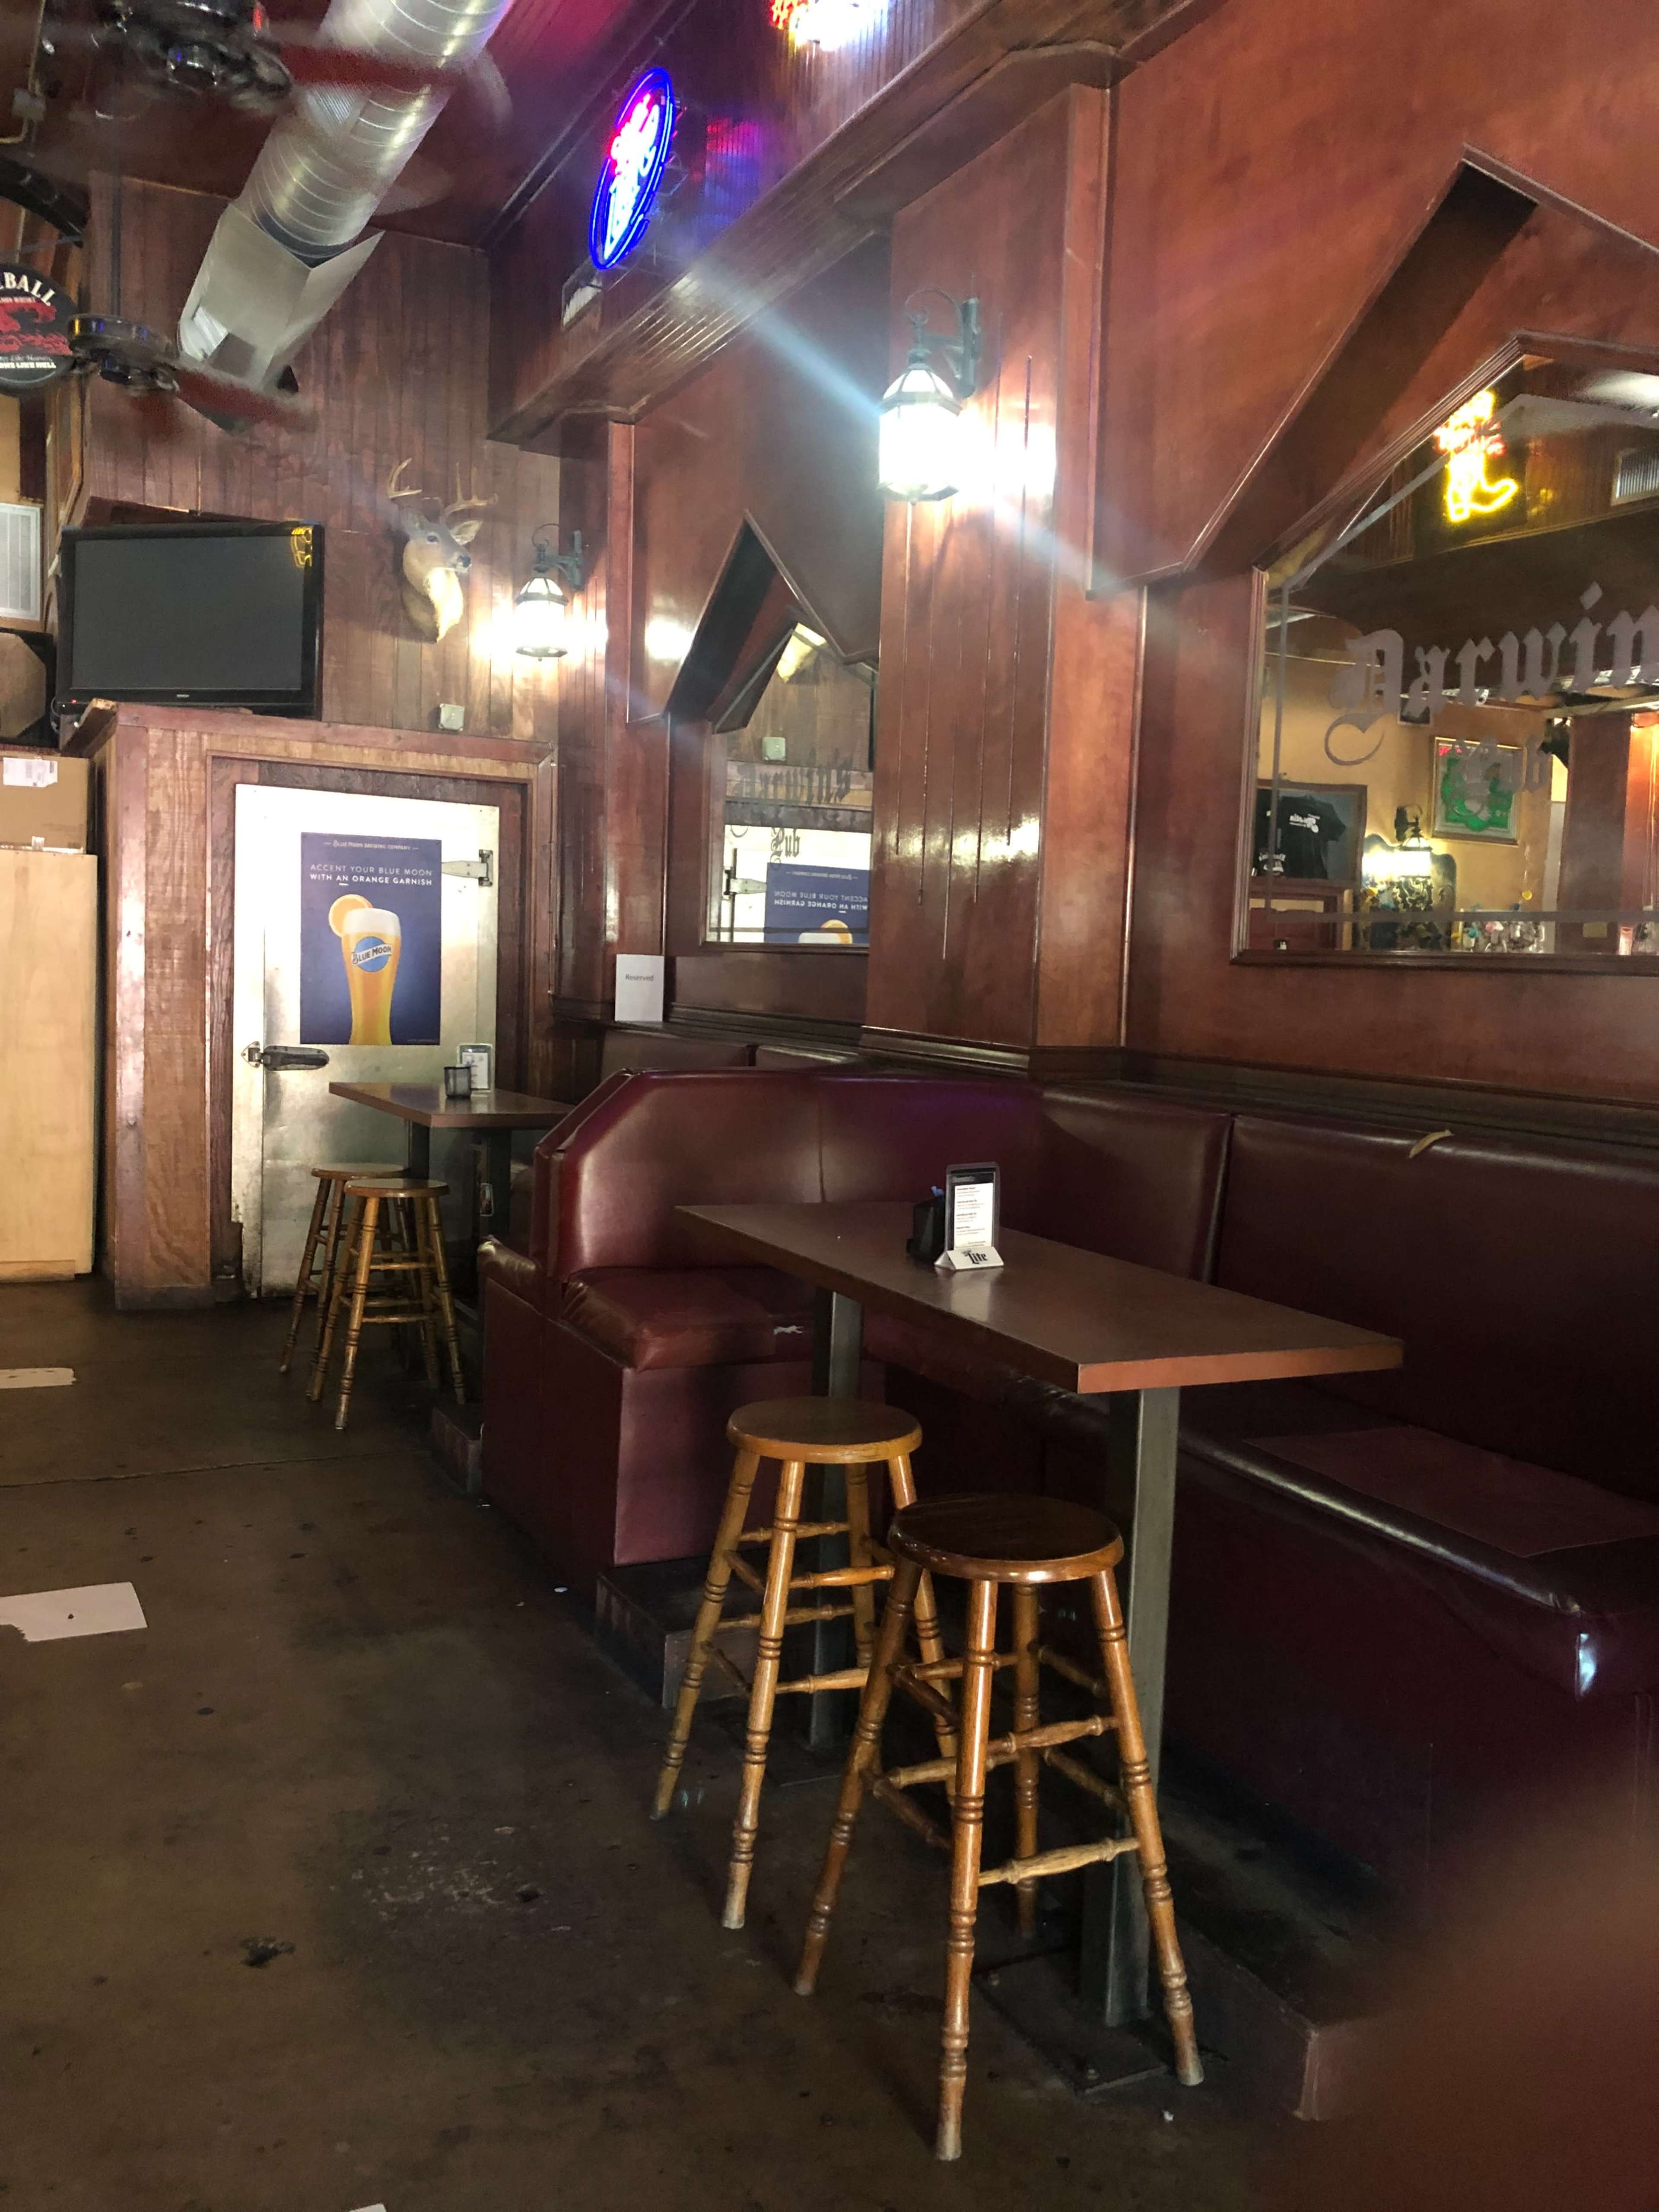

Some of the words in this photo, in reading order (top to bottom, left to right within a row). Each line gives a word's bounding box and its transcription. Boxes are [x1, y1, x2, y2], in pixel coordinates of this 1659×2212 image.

[0, 272, 55, 306] BALL
[352, 875, 389, 884] ORANGE
[352, 950, 371, 965] BLUE
[372, 946, 391, 956] MOON
[964, 1252, 988, 1265] Lite
